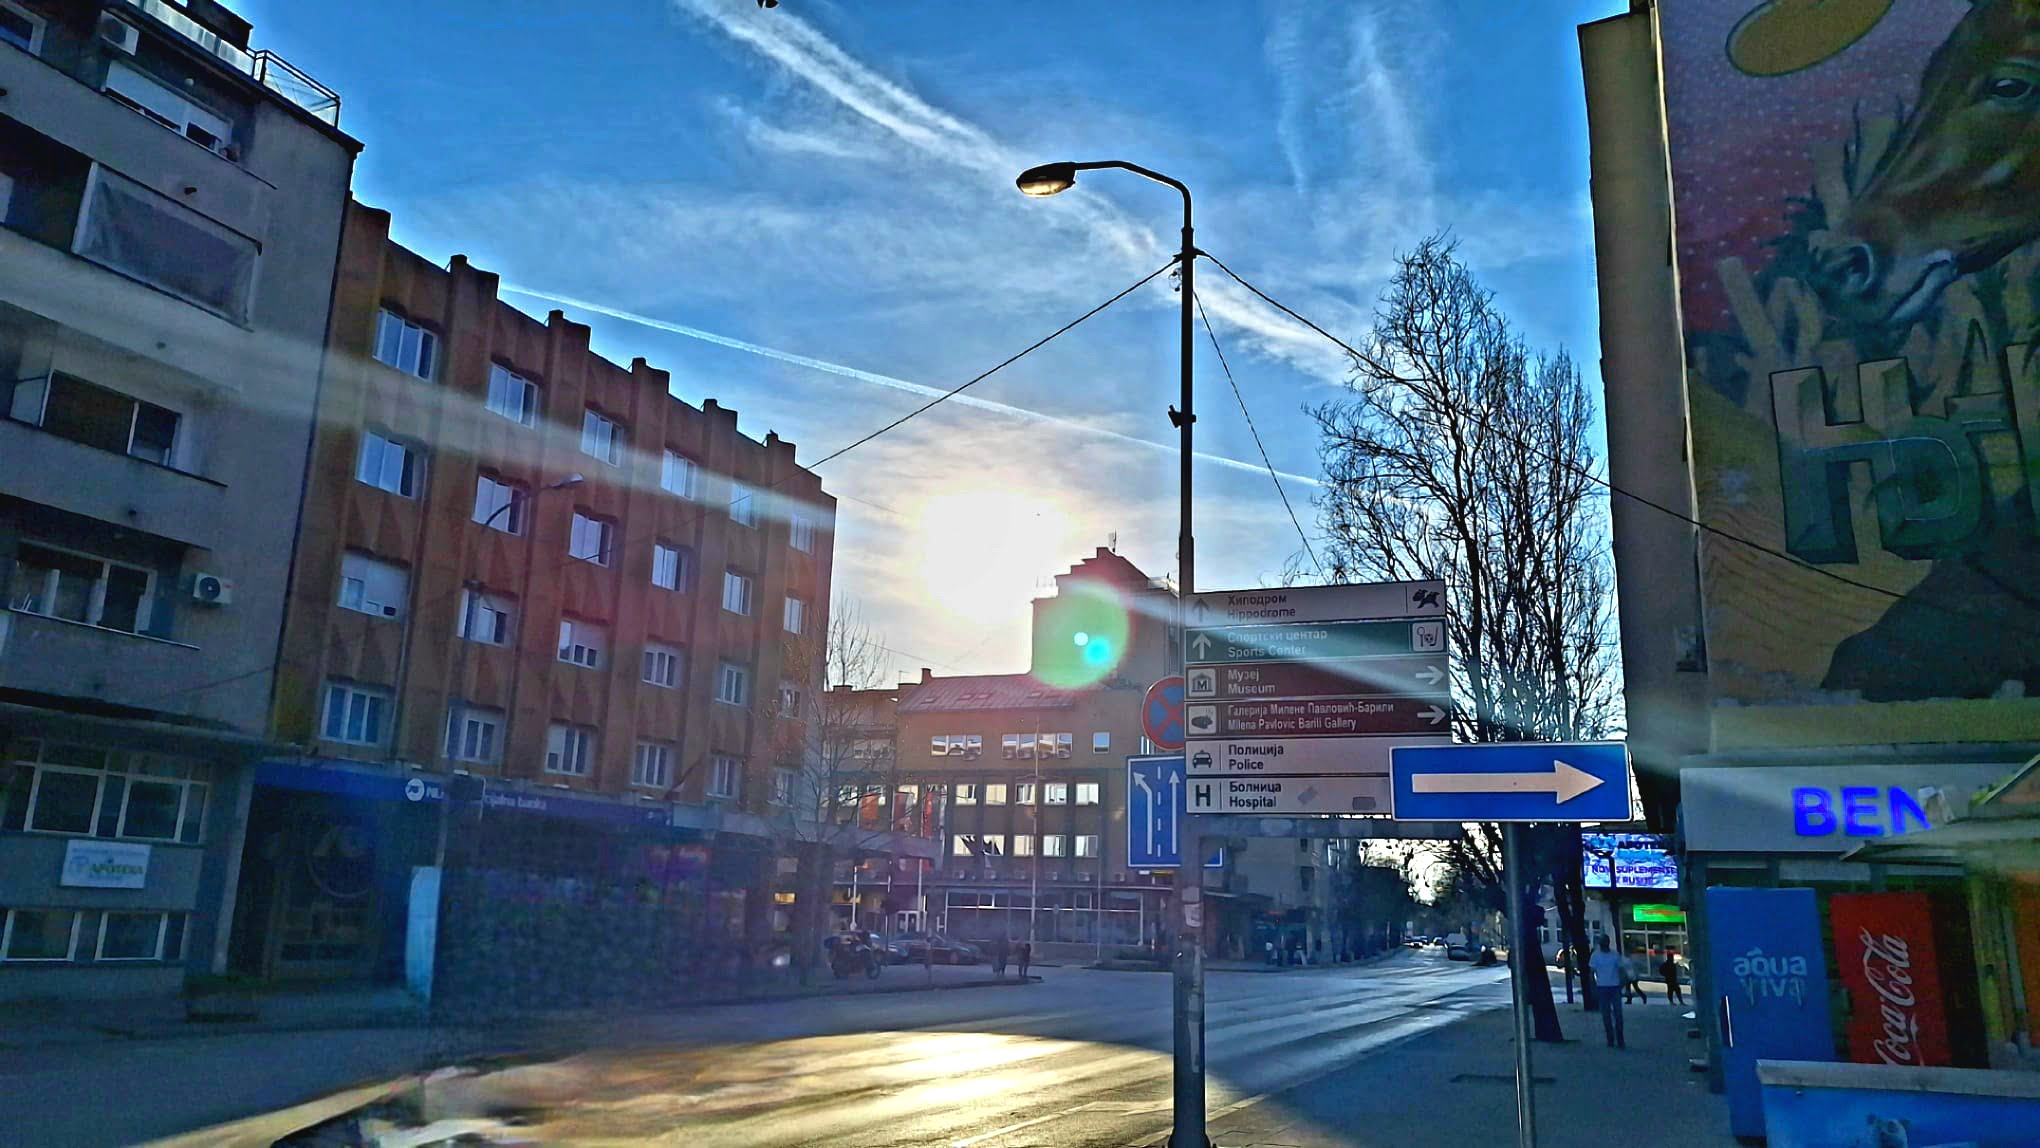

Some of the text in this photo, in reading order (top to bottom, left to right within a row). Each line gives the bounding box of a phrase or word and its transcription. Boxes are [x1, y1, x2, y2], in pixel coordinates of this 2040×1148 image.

[1228, 594, 1287, 607] Хиподром
[1228, 607, 1296, 621] Hippodrome
[1228, 629, 1328, 644] Спортски центар
[1228, 645, 1306, 660] Sports Center
[1228, 669, 1260, 682] Музеј
[1228, 683, 1276, 695] Museum
[1228, 704, 1268, 718] Галерија
[1270, 703, 1306, 715] Милене
[1228, 716, 1357, 731] Milena Pavlovic Barili Gallery
[1228, 744, 1284, 758] Полиција
[1228, 758, 1264, 770] Police
[1229, 781, 1282, 795] Болница
[1229, 796, 1277, 810] Hospital
